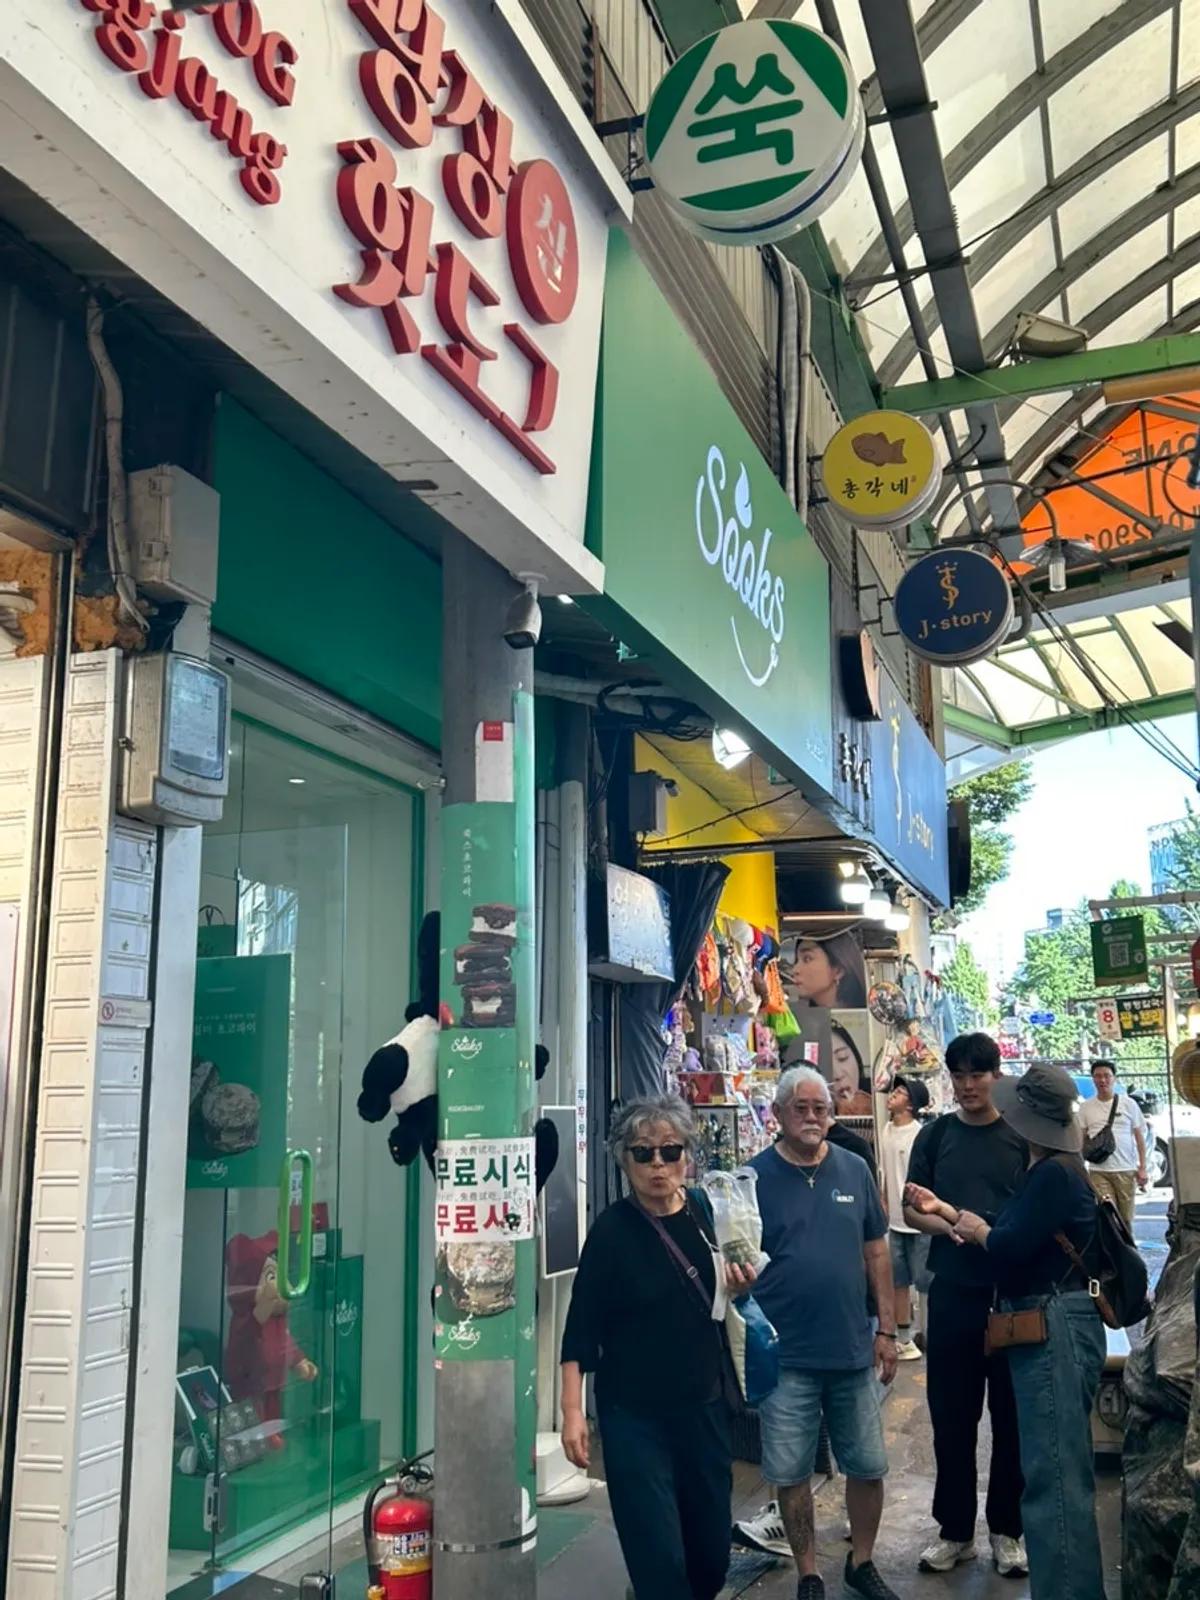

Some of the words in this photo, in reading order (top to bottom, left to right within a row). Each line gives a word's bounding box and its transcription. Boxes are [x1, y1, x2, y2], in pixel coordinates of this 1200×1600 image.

[685, 51, 805, 167] 쑥
[333, 137, 559, 474] 핫도그
[841, 477, 908, 500] 총각네
[1102, 1009, 1115, 1024] 8
